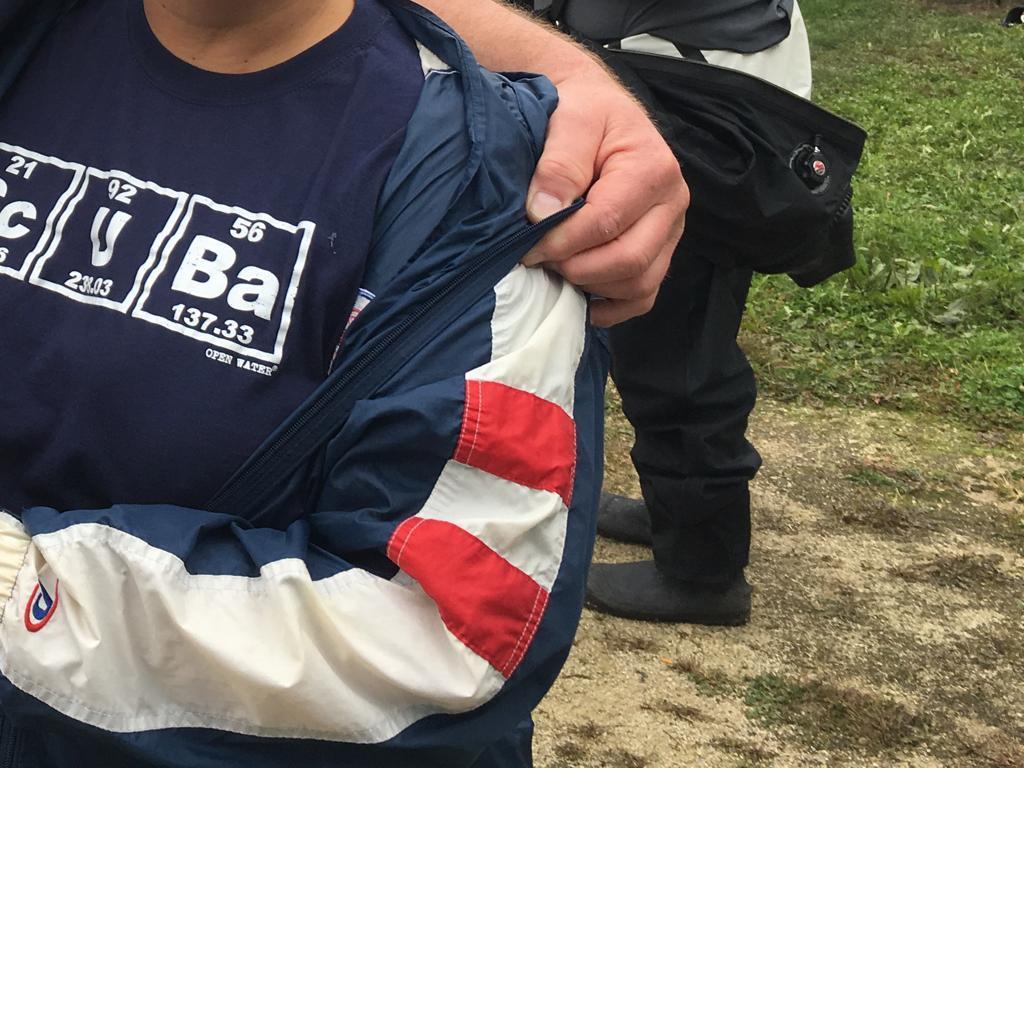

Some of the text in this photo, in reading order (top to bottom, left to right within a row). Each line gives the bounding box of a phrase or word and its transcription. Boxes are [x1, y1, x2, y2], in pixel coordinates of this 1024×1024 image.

[5, 155, 38, 180] 21
[107, 179, 138, 205] 92
[230, 216, 267, 243] 56
[170, 234, 281, 321] Ba
[171, 303, 255, 345] 137.33
[205, 348, 234, 365] OPEN
